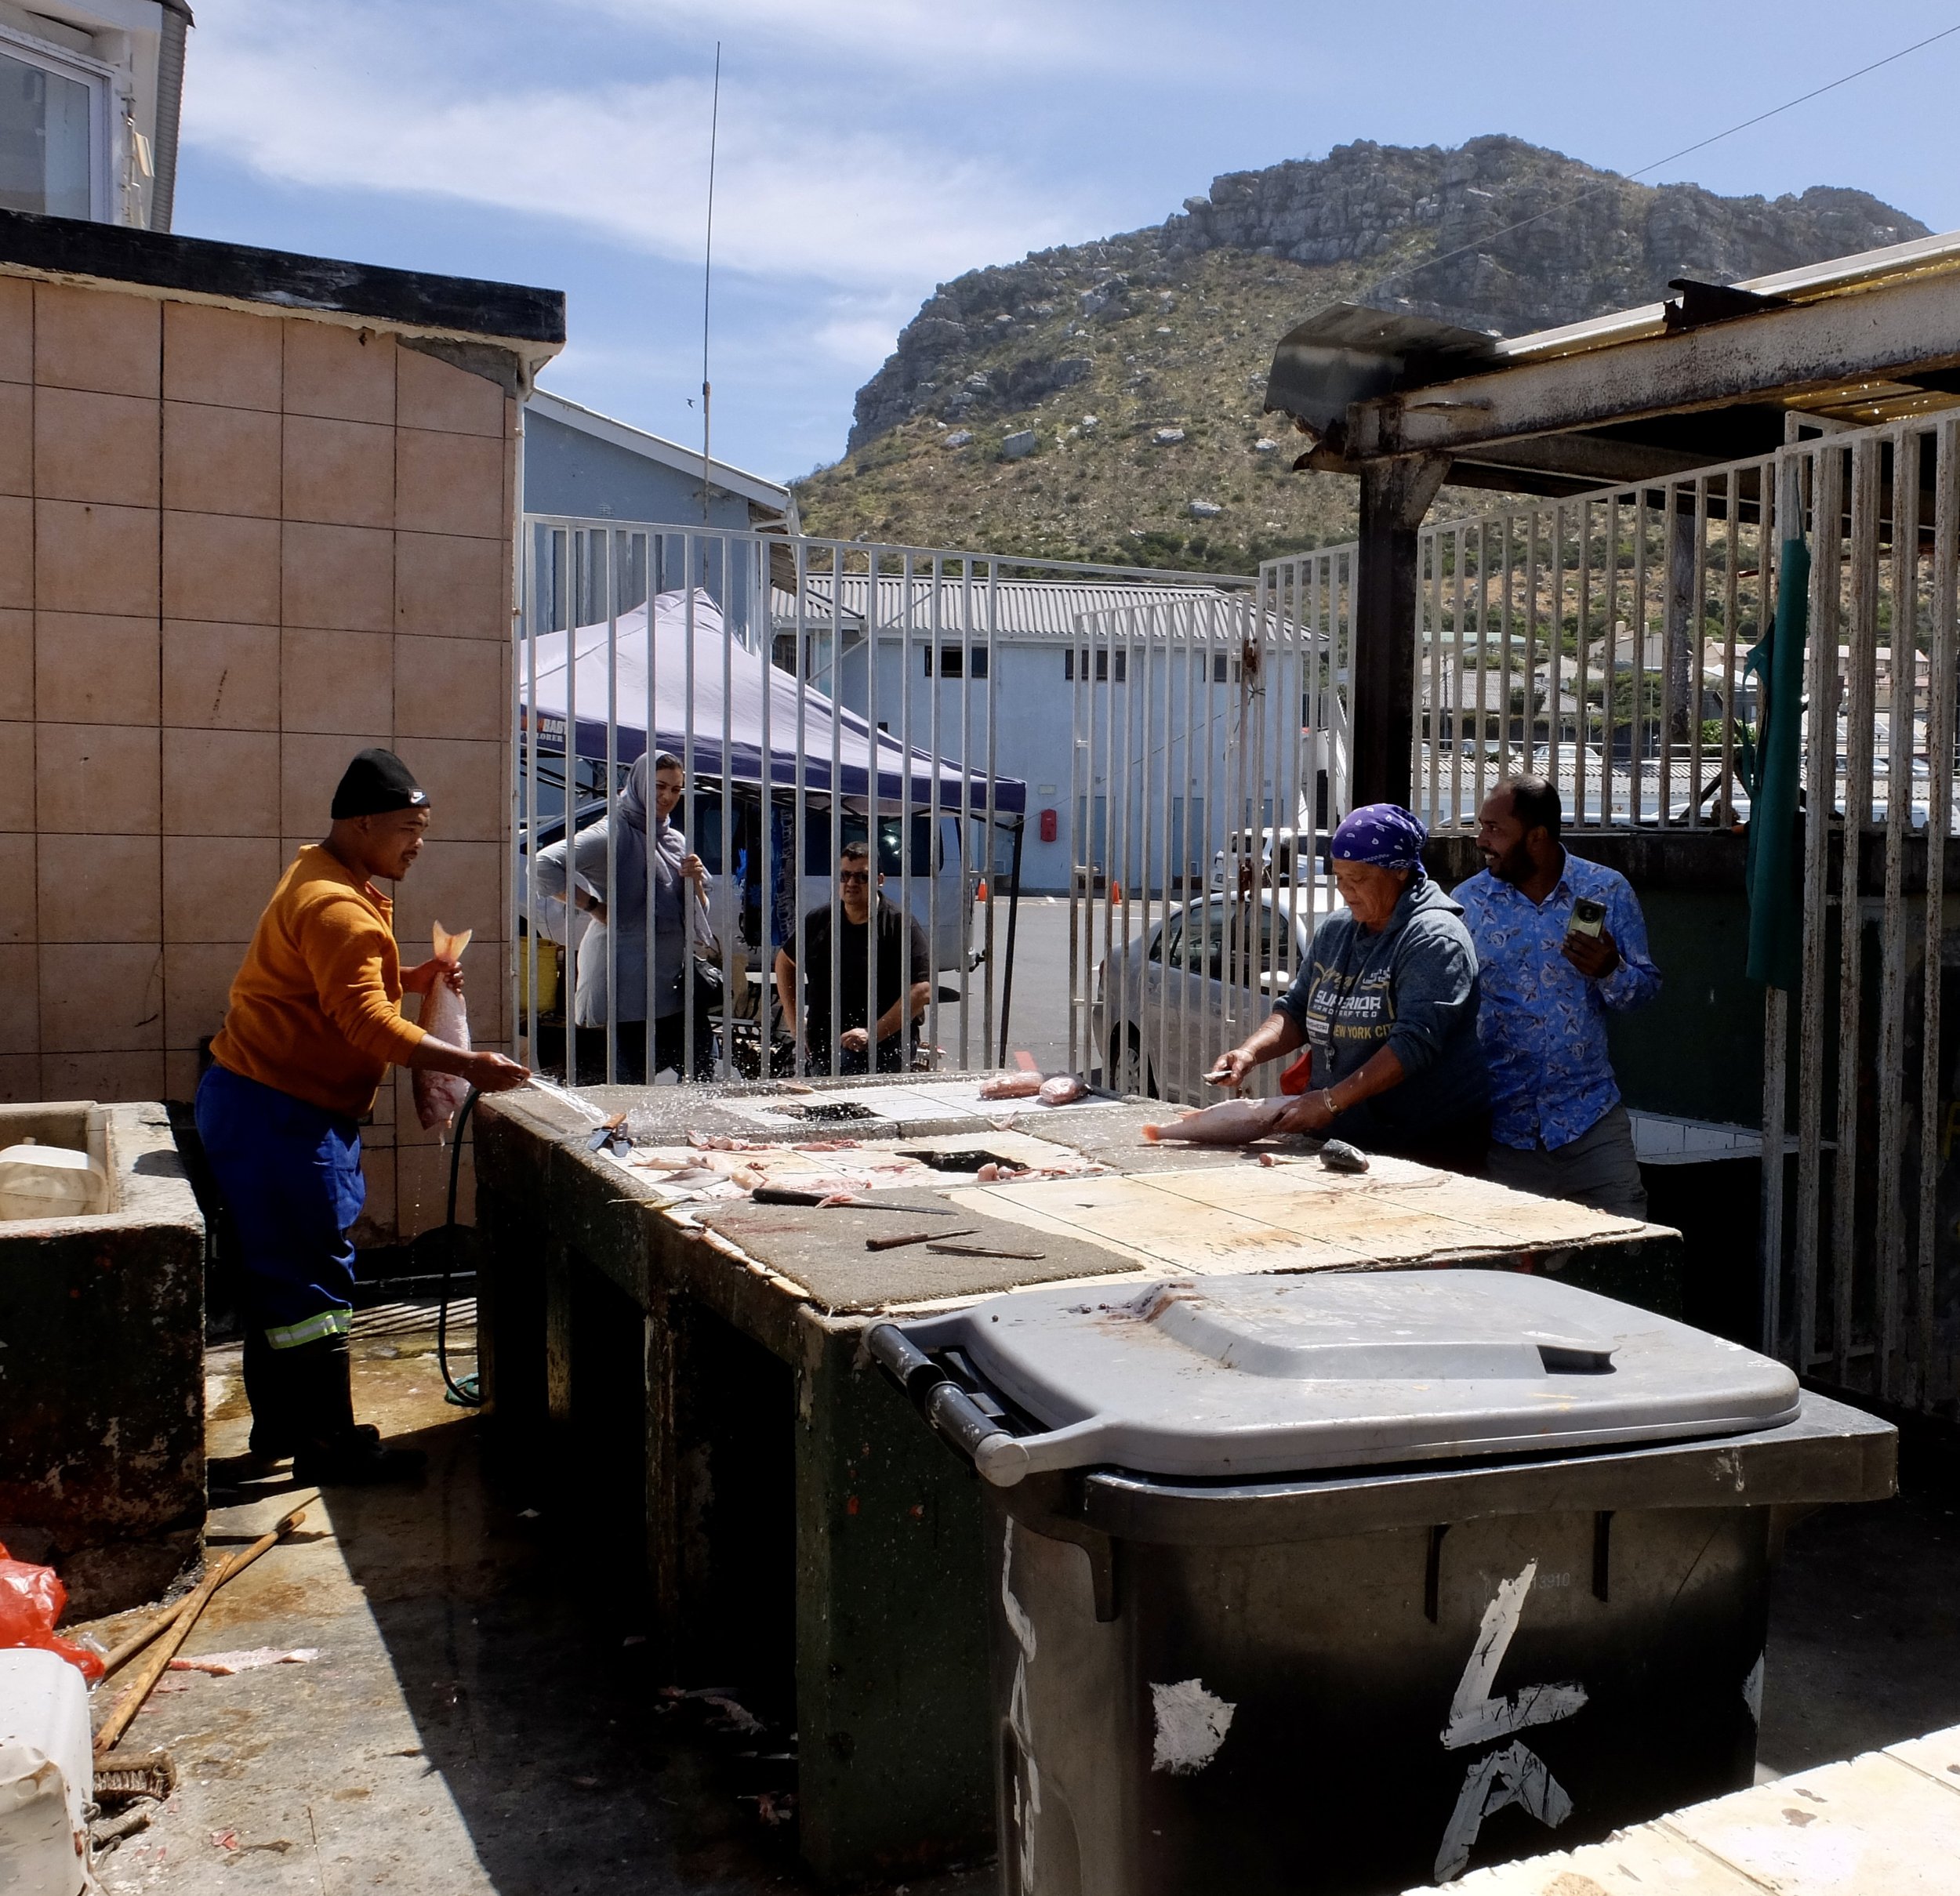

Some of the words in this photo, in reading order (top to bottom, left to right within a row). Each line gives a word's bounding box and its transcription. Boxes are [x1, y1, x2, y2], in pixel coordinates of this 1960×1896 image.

[1312, 1004, 1377, 1017] HANDRAFTED
[1348, 1026, 1372, 1039] YORK
[1375, 1023, 1395, 1038] CIT
